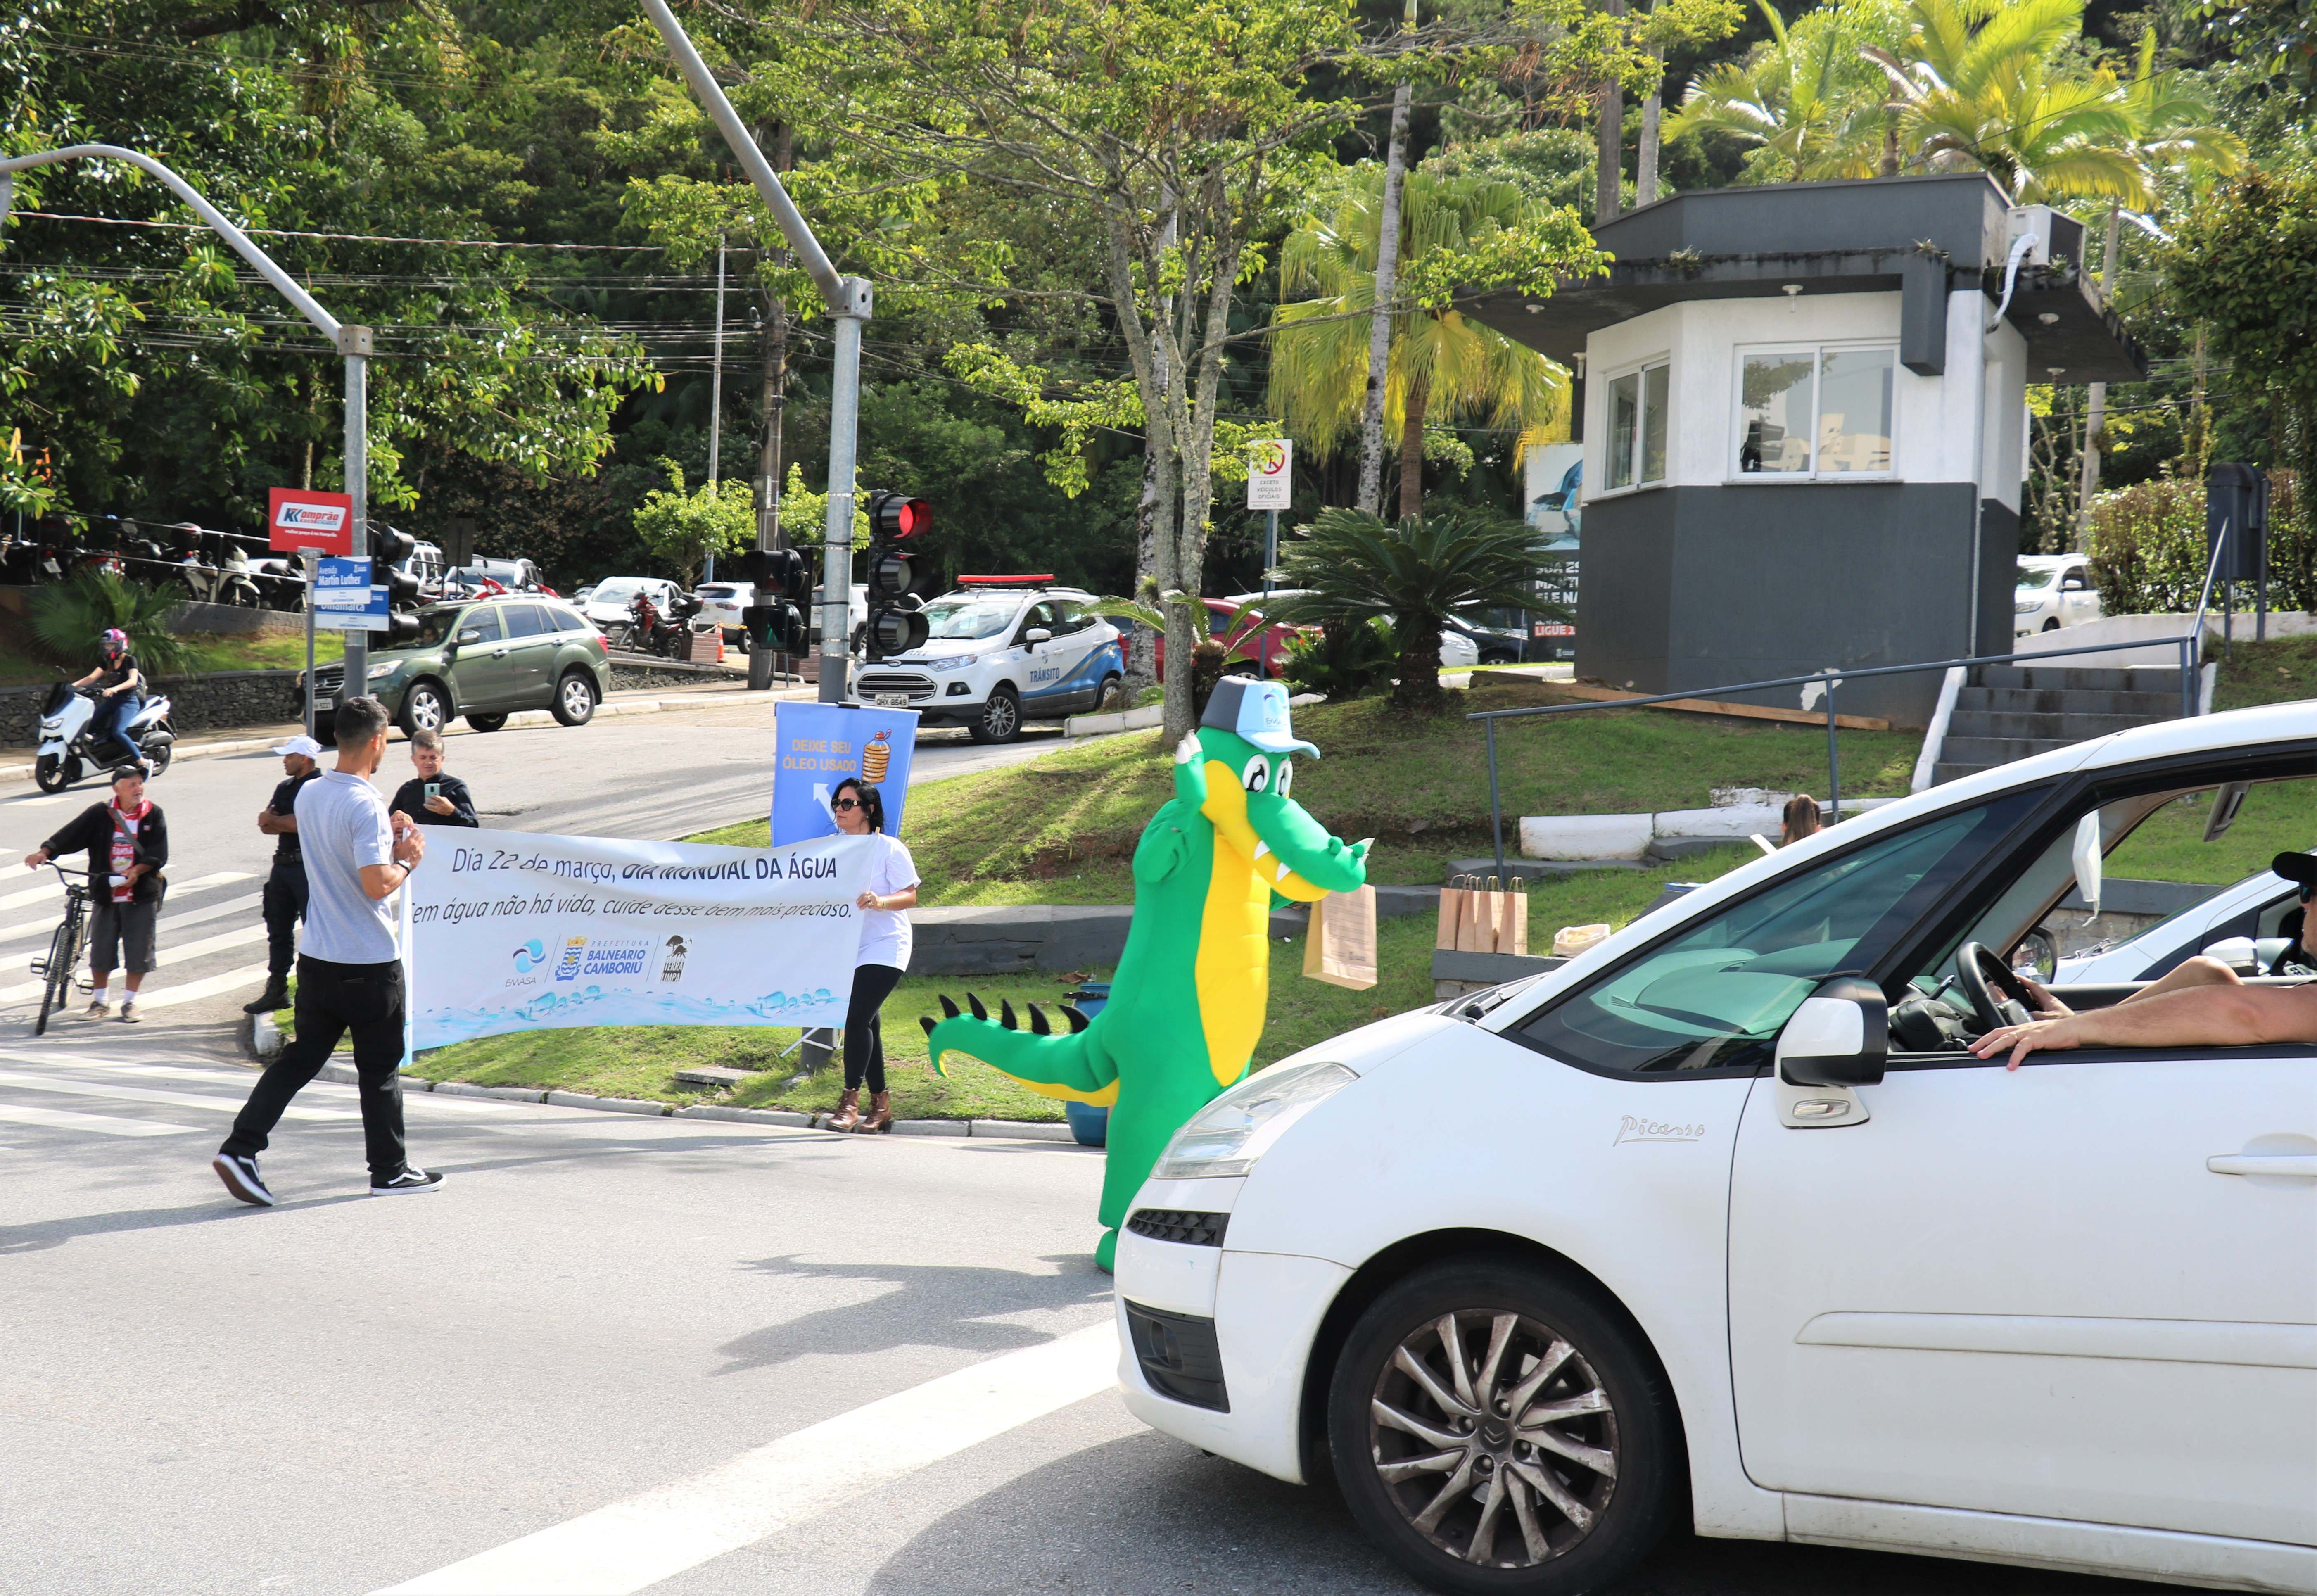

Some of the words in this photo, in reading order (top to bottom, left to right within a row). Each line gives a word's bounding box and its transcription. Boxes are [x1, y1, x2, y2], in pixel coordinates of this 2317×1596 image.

[319, 565, 337, 574] Avenida
[318, 575, 339, 585] Martin
[340, 573, 361, 585] Luther
[1535, 625, 1567, 635] LIGUE
[1568, 625, 1576, 635] 1
[1030, 667, 1060, 683] TRÂNSITO
[792, 739, 827, 753] DEIXE
[830, 741, 852, 754] SEU
[783, 754, 817, 770] ÓLEO
[819, 758, 857, 772] USADO
[452, 848, 483, 872] Dia
[488, 850, 519, 870] 22
[519, 853, 548, 872] de
[552, 860, 615, 884] março,
[622, 863, 660, 880] DIA
[659, 859, 750, 880] MUNDIAL
[756, 857, 783, 879] DA
[788, 852, 837, 879] ÁGUA
[412, 902, 439, 924] em
[443, 896, 490, 924] água
[491, 894, 527, 916] não
[529, 893, 555, 914] há
[557, 893, 596, 916] vida,
[603, 899, 653, 914] cuide
[653, 902, 705, 916] desse
[704, 903, 745, 917] bem
[743, 902, 784, 917] mais
[779, 901, 852, 919] precioso.
[587, 948, 646, 960] BALNEÁRIO
[584, 961, 643, 974] CAMBORIÚ
[664, 962, 684, 971] TERRA
[505, 976, 536, 987] EMASA
[661, 972, 681, 982] LIMPA
[1612, 1114, 1705, 1147] Picasso
